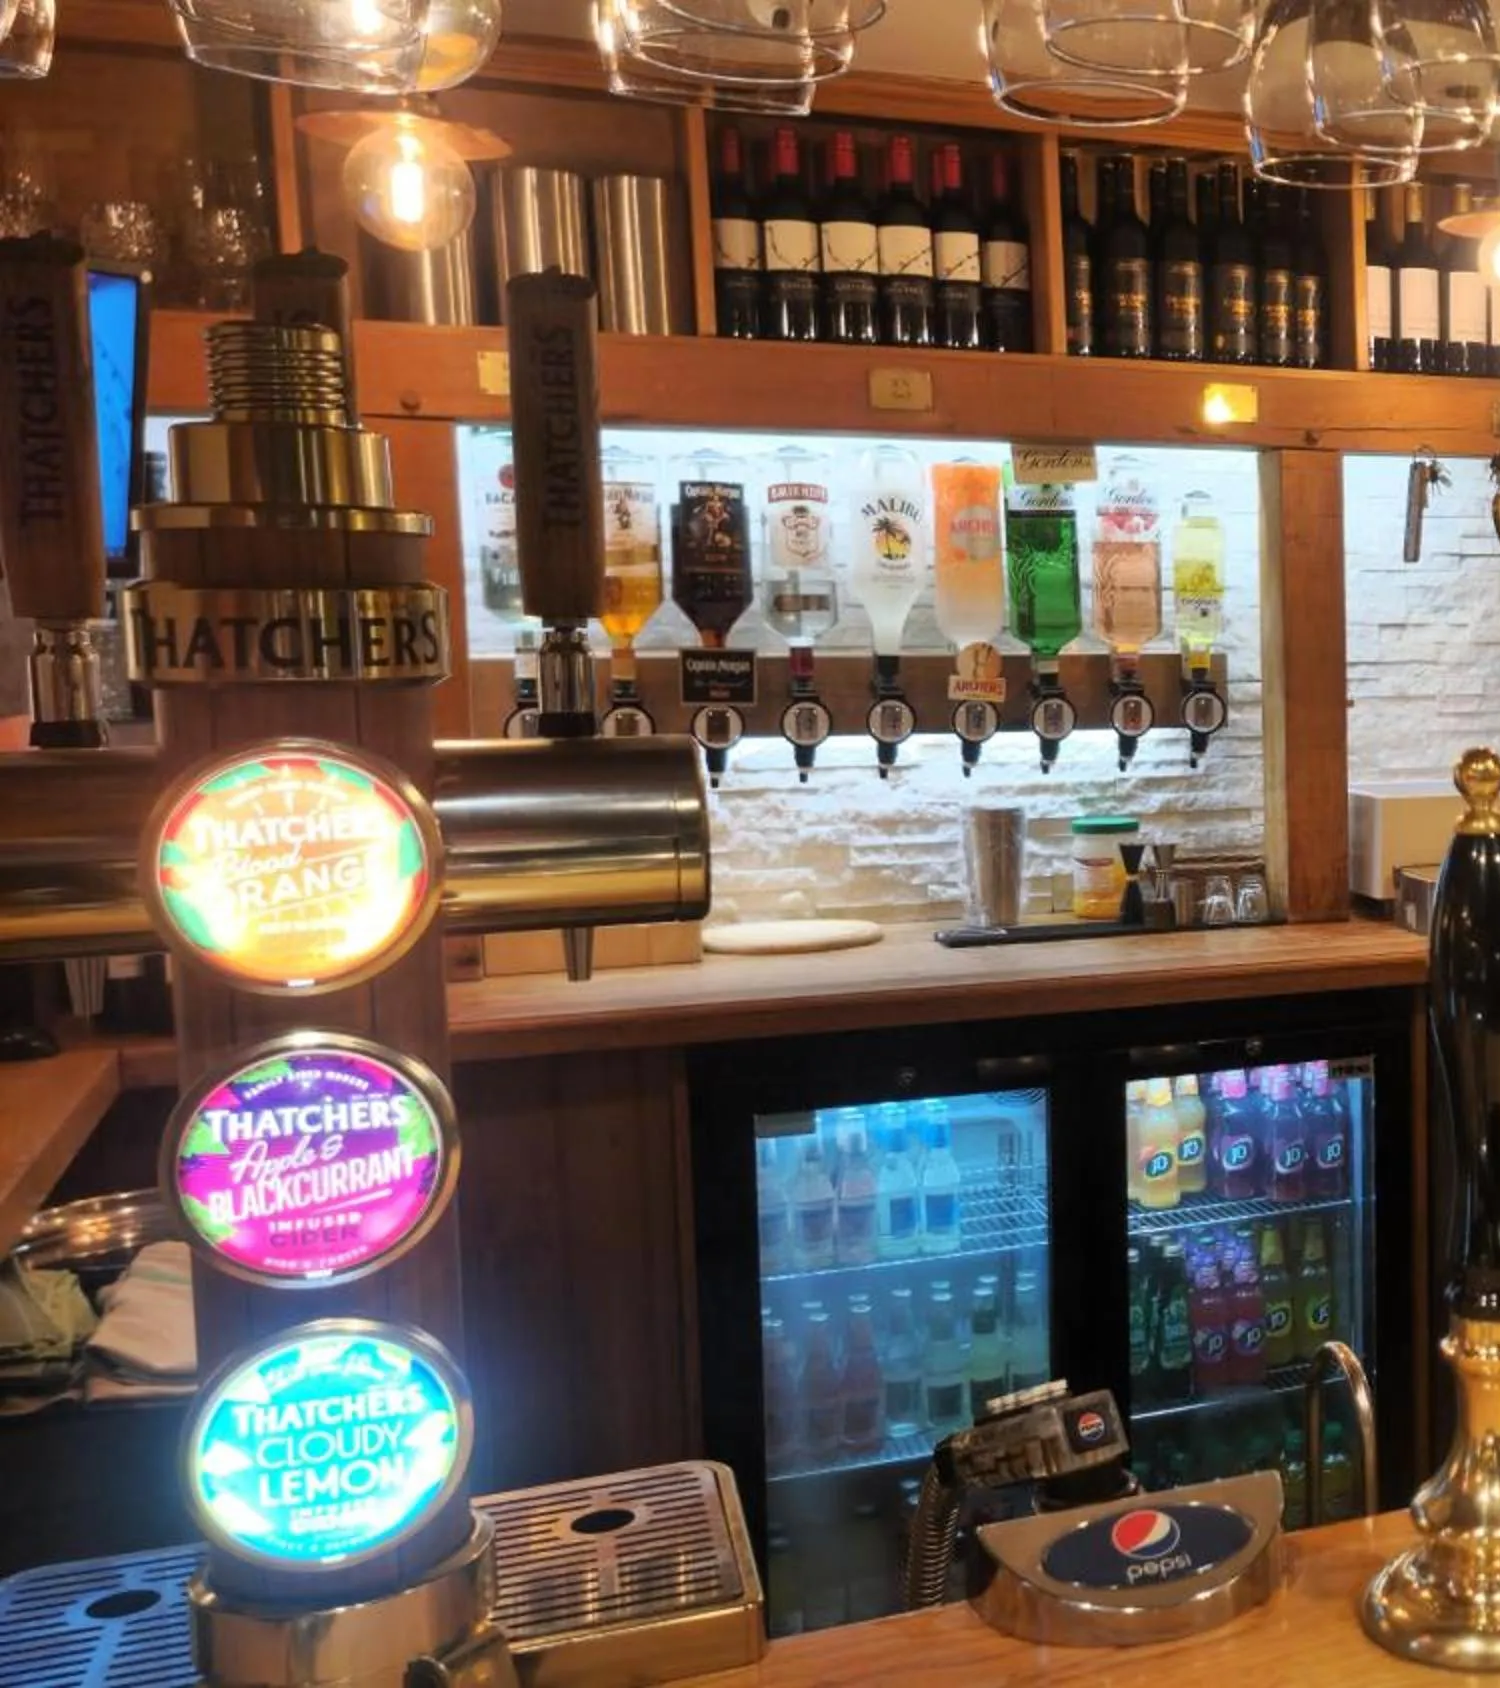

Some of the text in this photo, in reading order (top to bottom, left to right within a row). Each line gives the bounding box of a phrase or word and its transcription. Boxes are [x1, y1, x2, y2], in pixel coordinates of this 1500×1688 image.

[18, 296, 64, 526] THATCHERS
[541, 320, 583, 531] THATCHERS
[861, 496, 922, 522] MALIBU
[132, 607, 440, 669] THATCHERS
[205, 1095, 412, 1143] THATCHERS
[208, 1144, 416, 1224] BLACKCURRANT
[229, 1138, 315, 1186] Apple
[269, 1211, 362, 1233] INFUSED
[269, 1226, 361, 1248] CIDER
[232, 1384, 425, 1438] THATCHERS
[256, 1422, 406, 1470] CLOUDY
[259, 1456, 407, 1507] LEMON
[1126, 1552, 1192, 1584] pepsi
